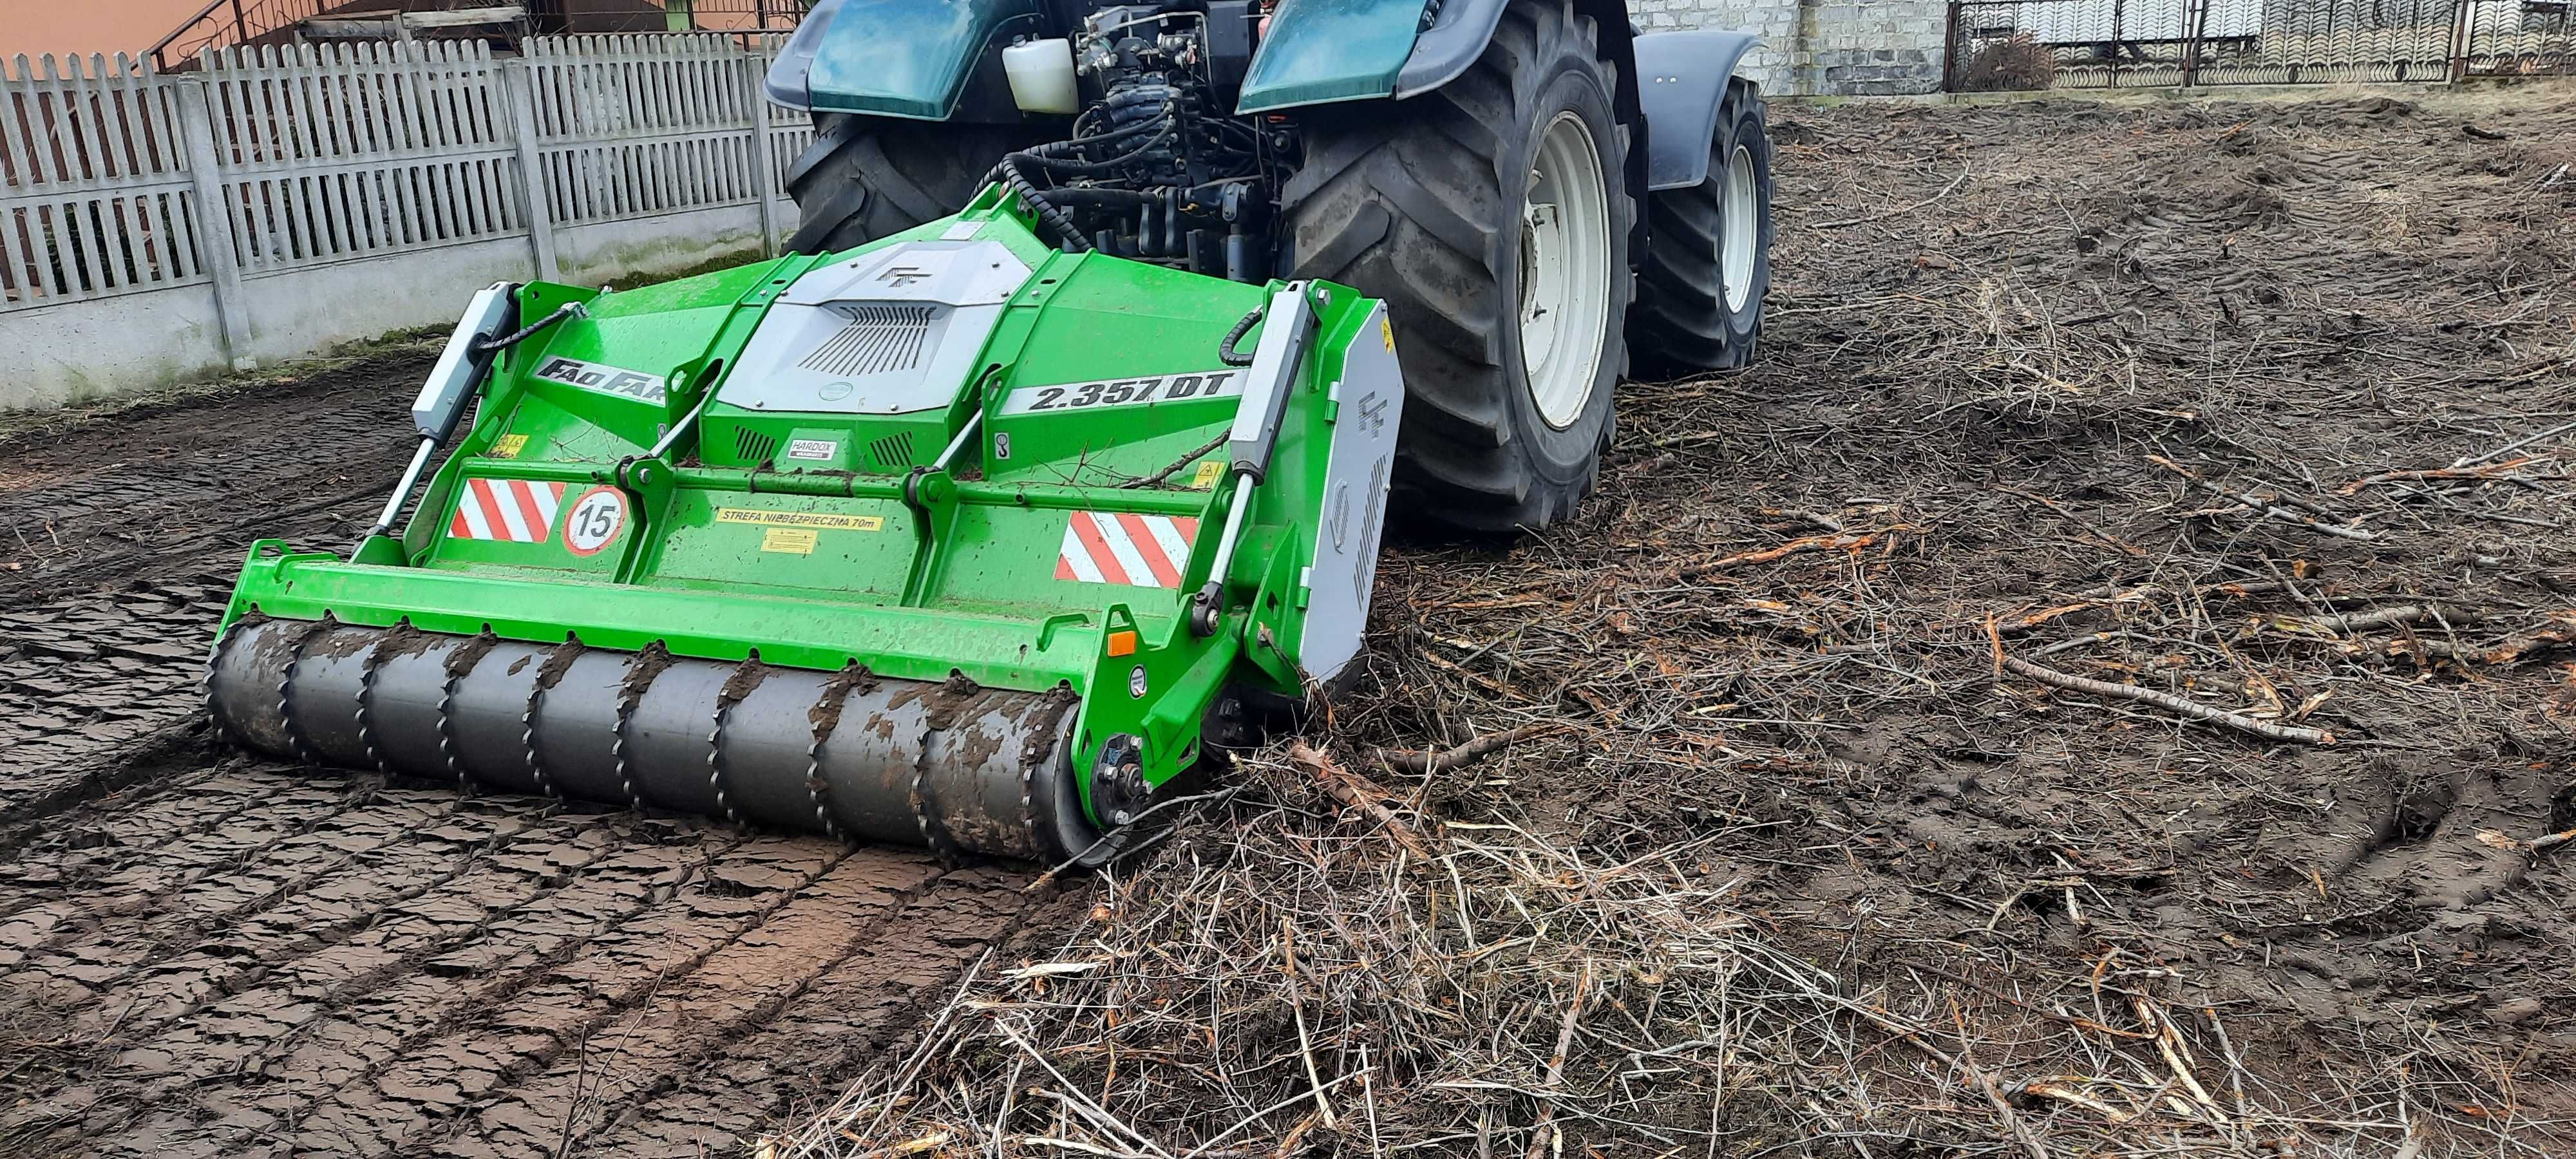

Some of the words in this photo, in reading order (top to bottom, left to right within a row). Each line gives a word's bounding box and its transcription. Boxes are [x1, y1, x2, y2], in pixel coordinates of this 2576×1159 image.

[537, 359, 606, 386] FAO
[601, 372, 665, 401] FAR
[1028, 379, 1162, 410] 2.357
[1164, 372, 1235, 399] DT
[792, 442, 831, 451] HARDOX
[578, 504, 616, 538] 15
[722, 511, 762, 522] STREFA
[764, 513, 849, 527] NIEBEZPIECZNA
[851, 518, 875, 528] 70m
